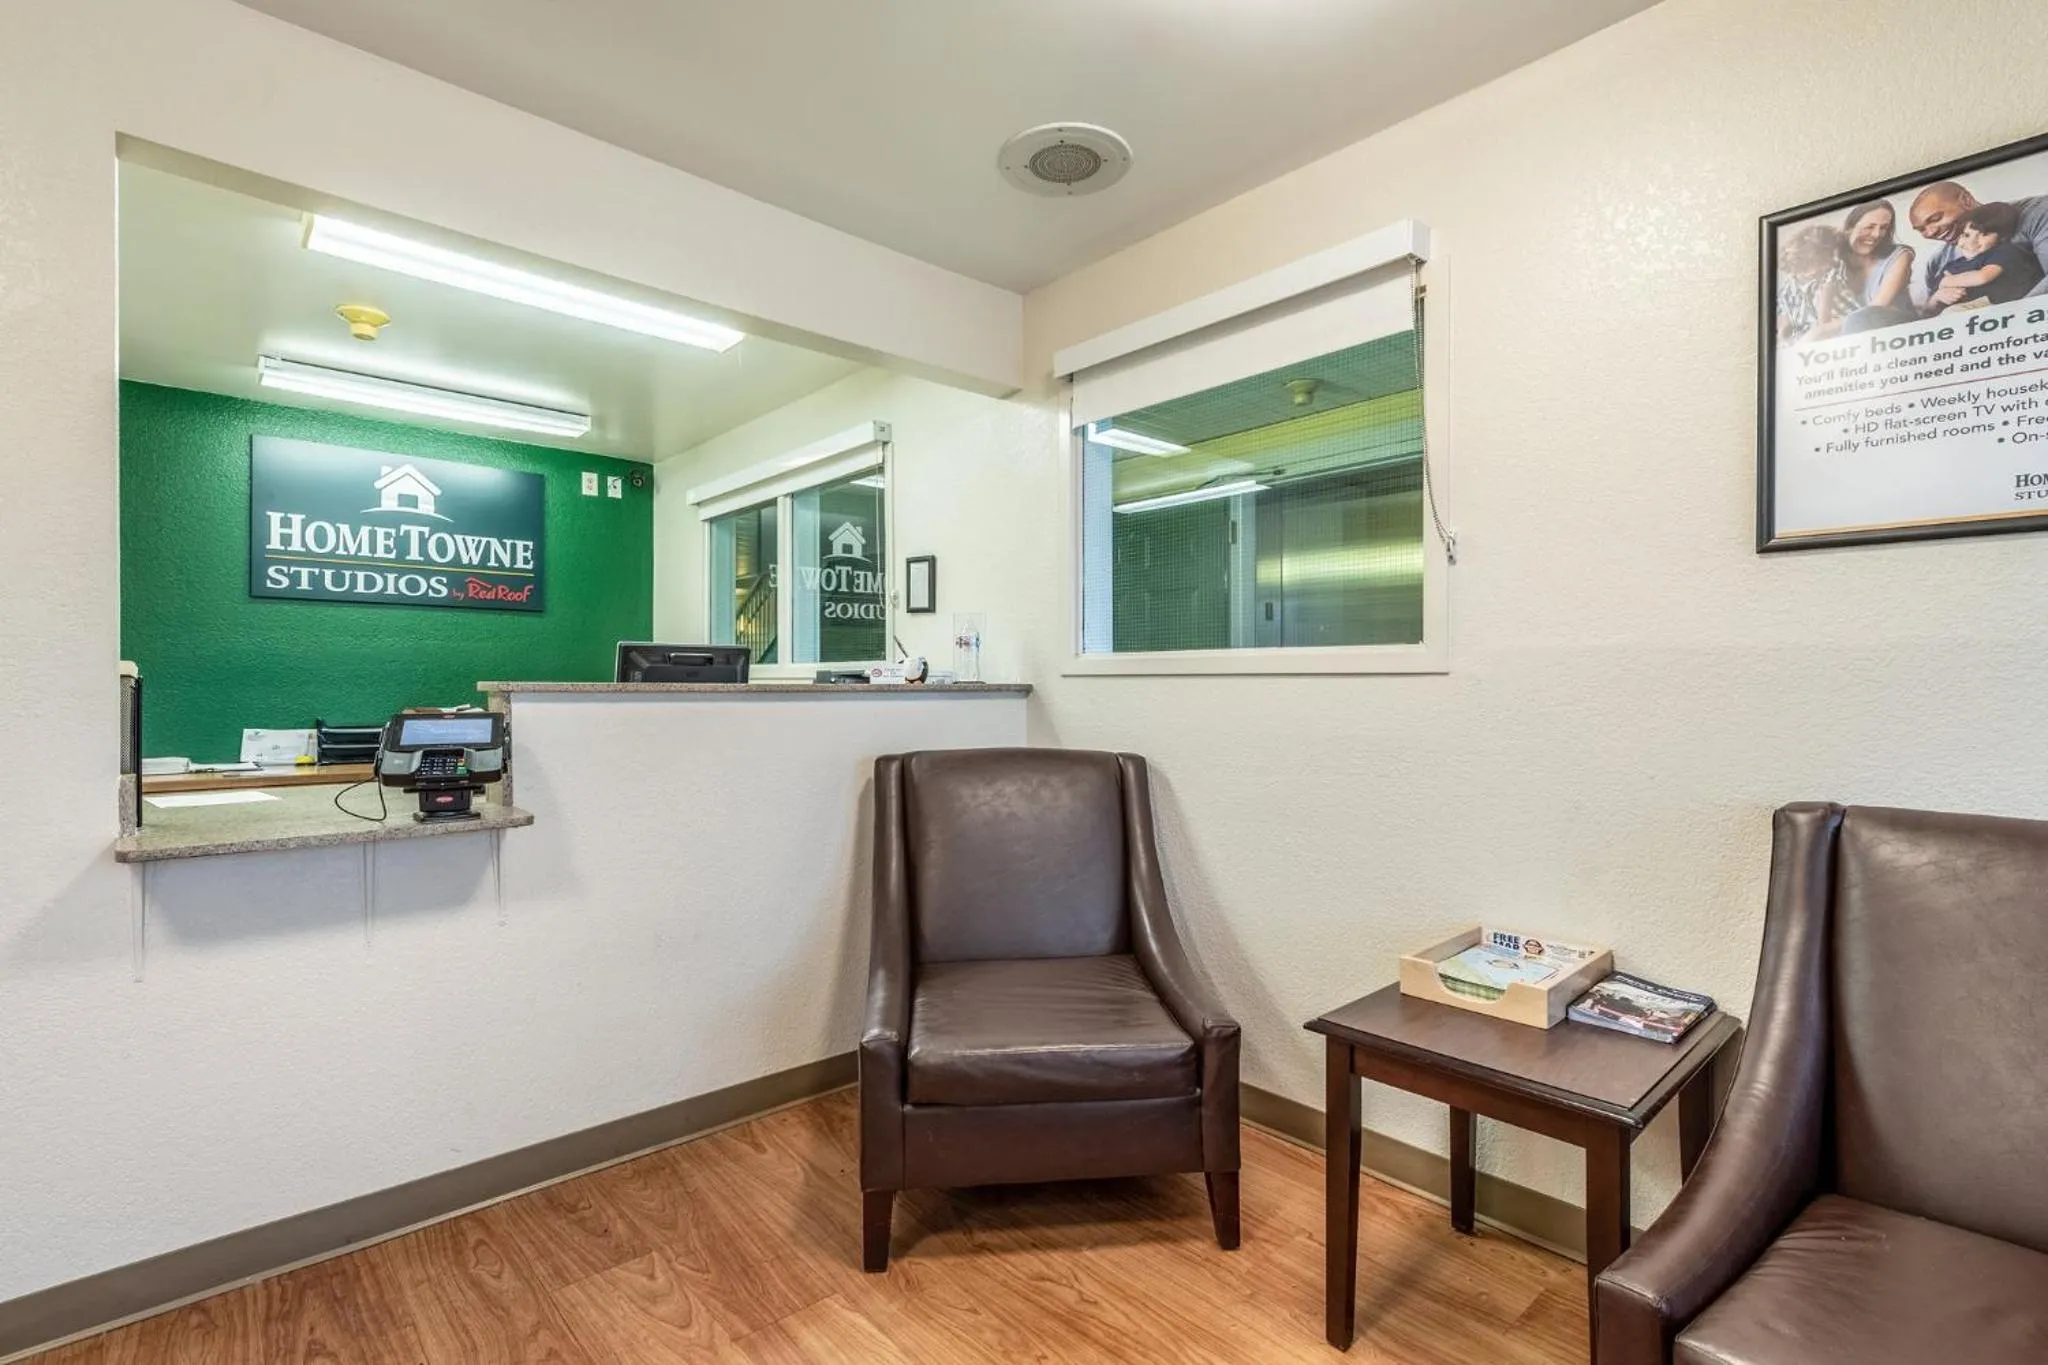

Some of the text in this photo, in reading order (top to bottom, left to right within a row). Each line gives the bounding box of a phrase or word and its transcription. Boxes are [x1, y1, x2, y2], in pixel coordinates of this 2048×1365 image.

[1796, 332, 2048, 386] You'll find a clean and comforta
[1798, 308, 2048, 367] Your home for a
[1804, 379, 1875, 400] amenities
[1880, 374, 1908, 390] you
[1914, 363, 1954, 380] need
[1960, 356, 1991, 372] and
[1997, 353, 2026, 366] the
[1812, 378, 2048, 426] Comfy beds Weekly housek
[1854, 421, 1879, 434] HD
[1884, 411, 1967, 430] flat-screen
[1972, 403, 1996, 417] TV
[2001, 397, 2039, 414] with
[1826, 414, 2048, 453] Fully furnished rooms Fre
[265, 564, 450, 599] STUDIOS
[452, 588, 465, 601] by
[1493, 932, 1520, 944] FREE
